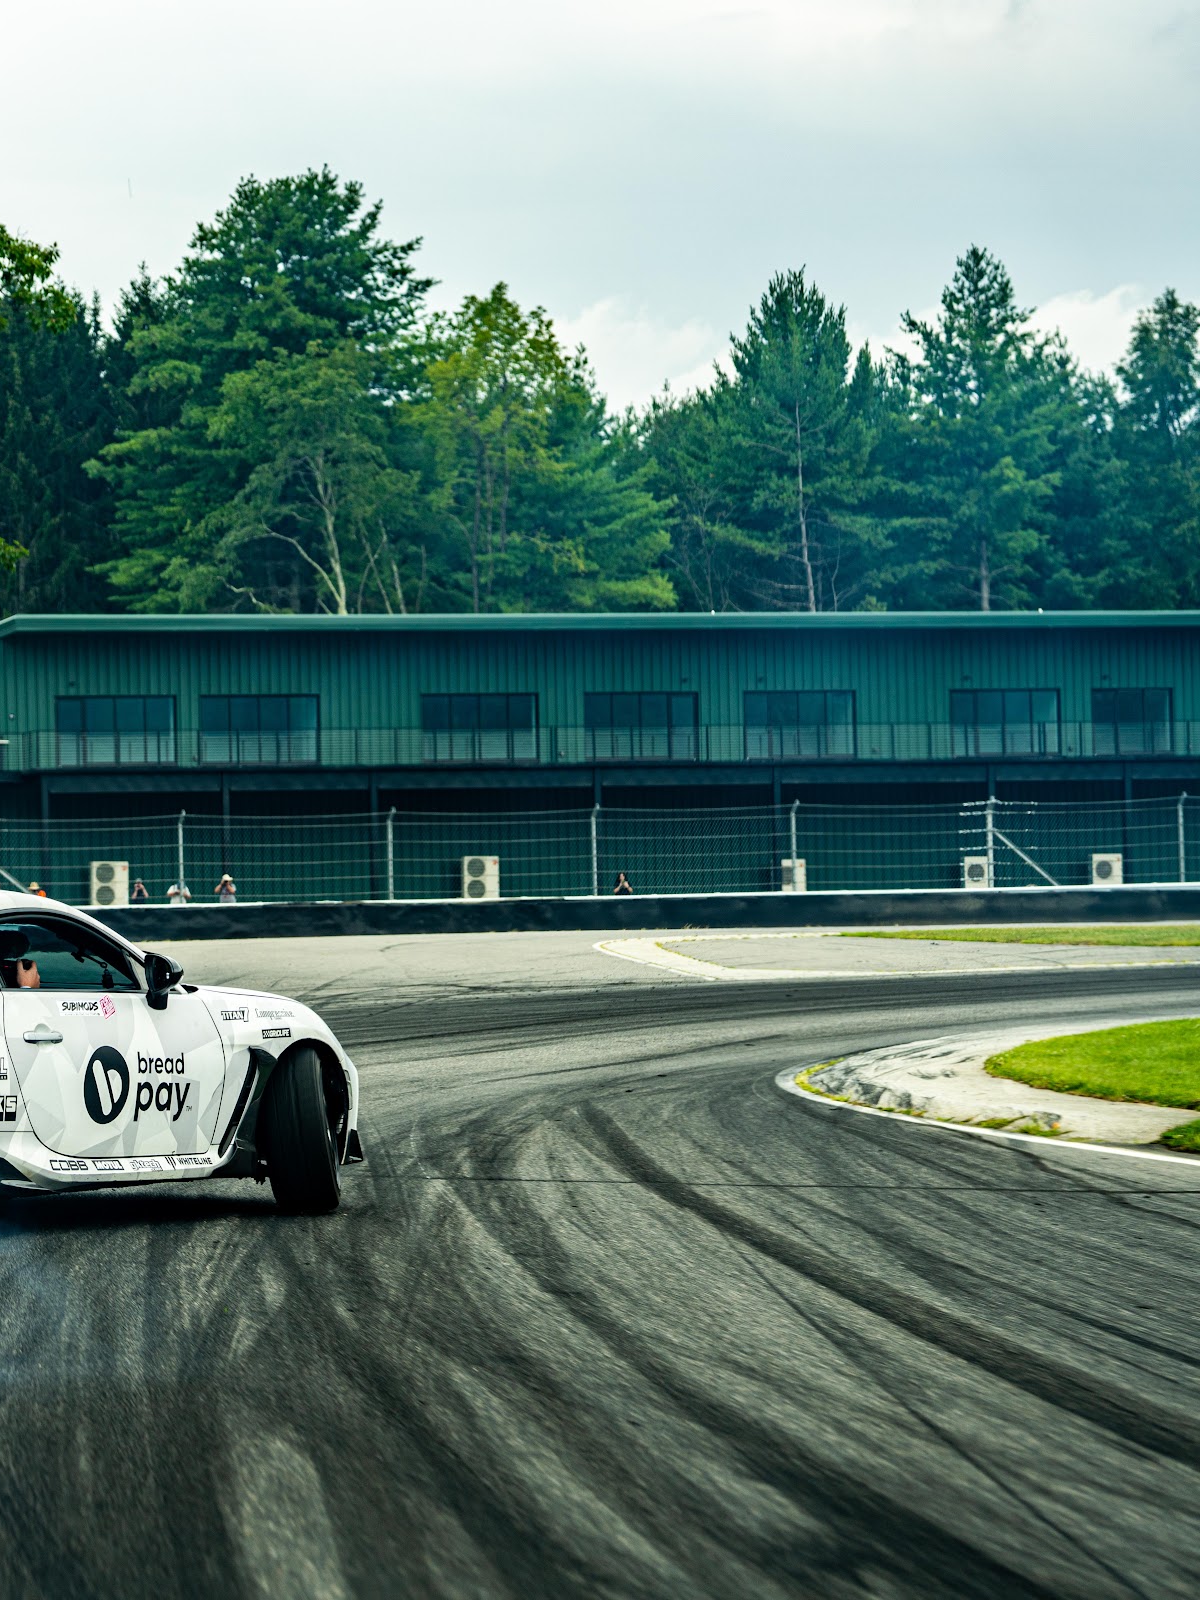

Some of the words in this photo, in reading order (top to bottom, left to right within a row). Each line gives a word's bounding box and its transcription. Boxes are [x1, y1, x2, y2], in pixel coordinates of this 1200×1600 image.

[137, 1051, 185, 1075] bread
[133, 1082, 191, 1122] pay
[94, 1160, 124, 1170] MOTUL
[176, 1157, 213, 1165] WHITELINE
